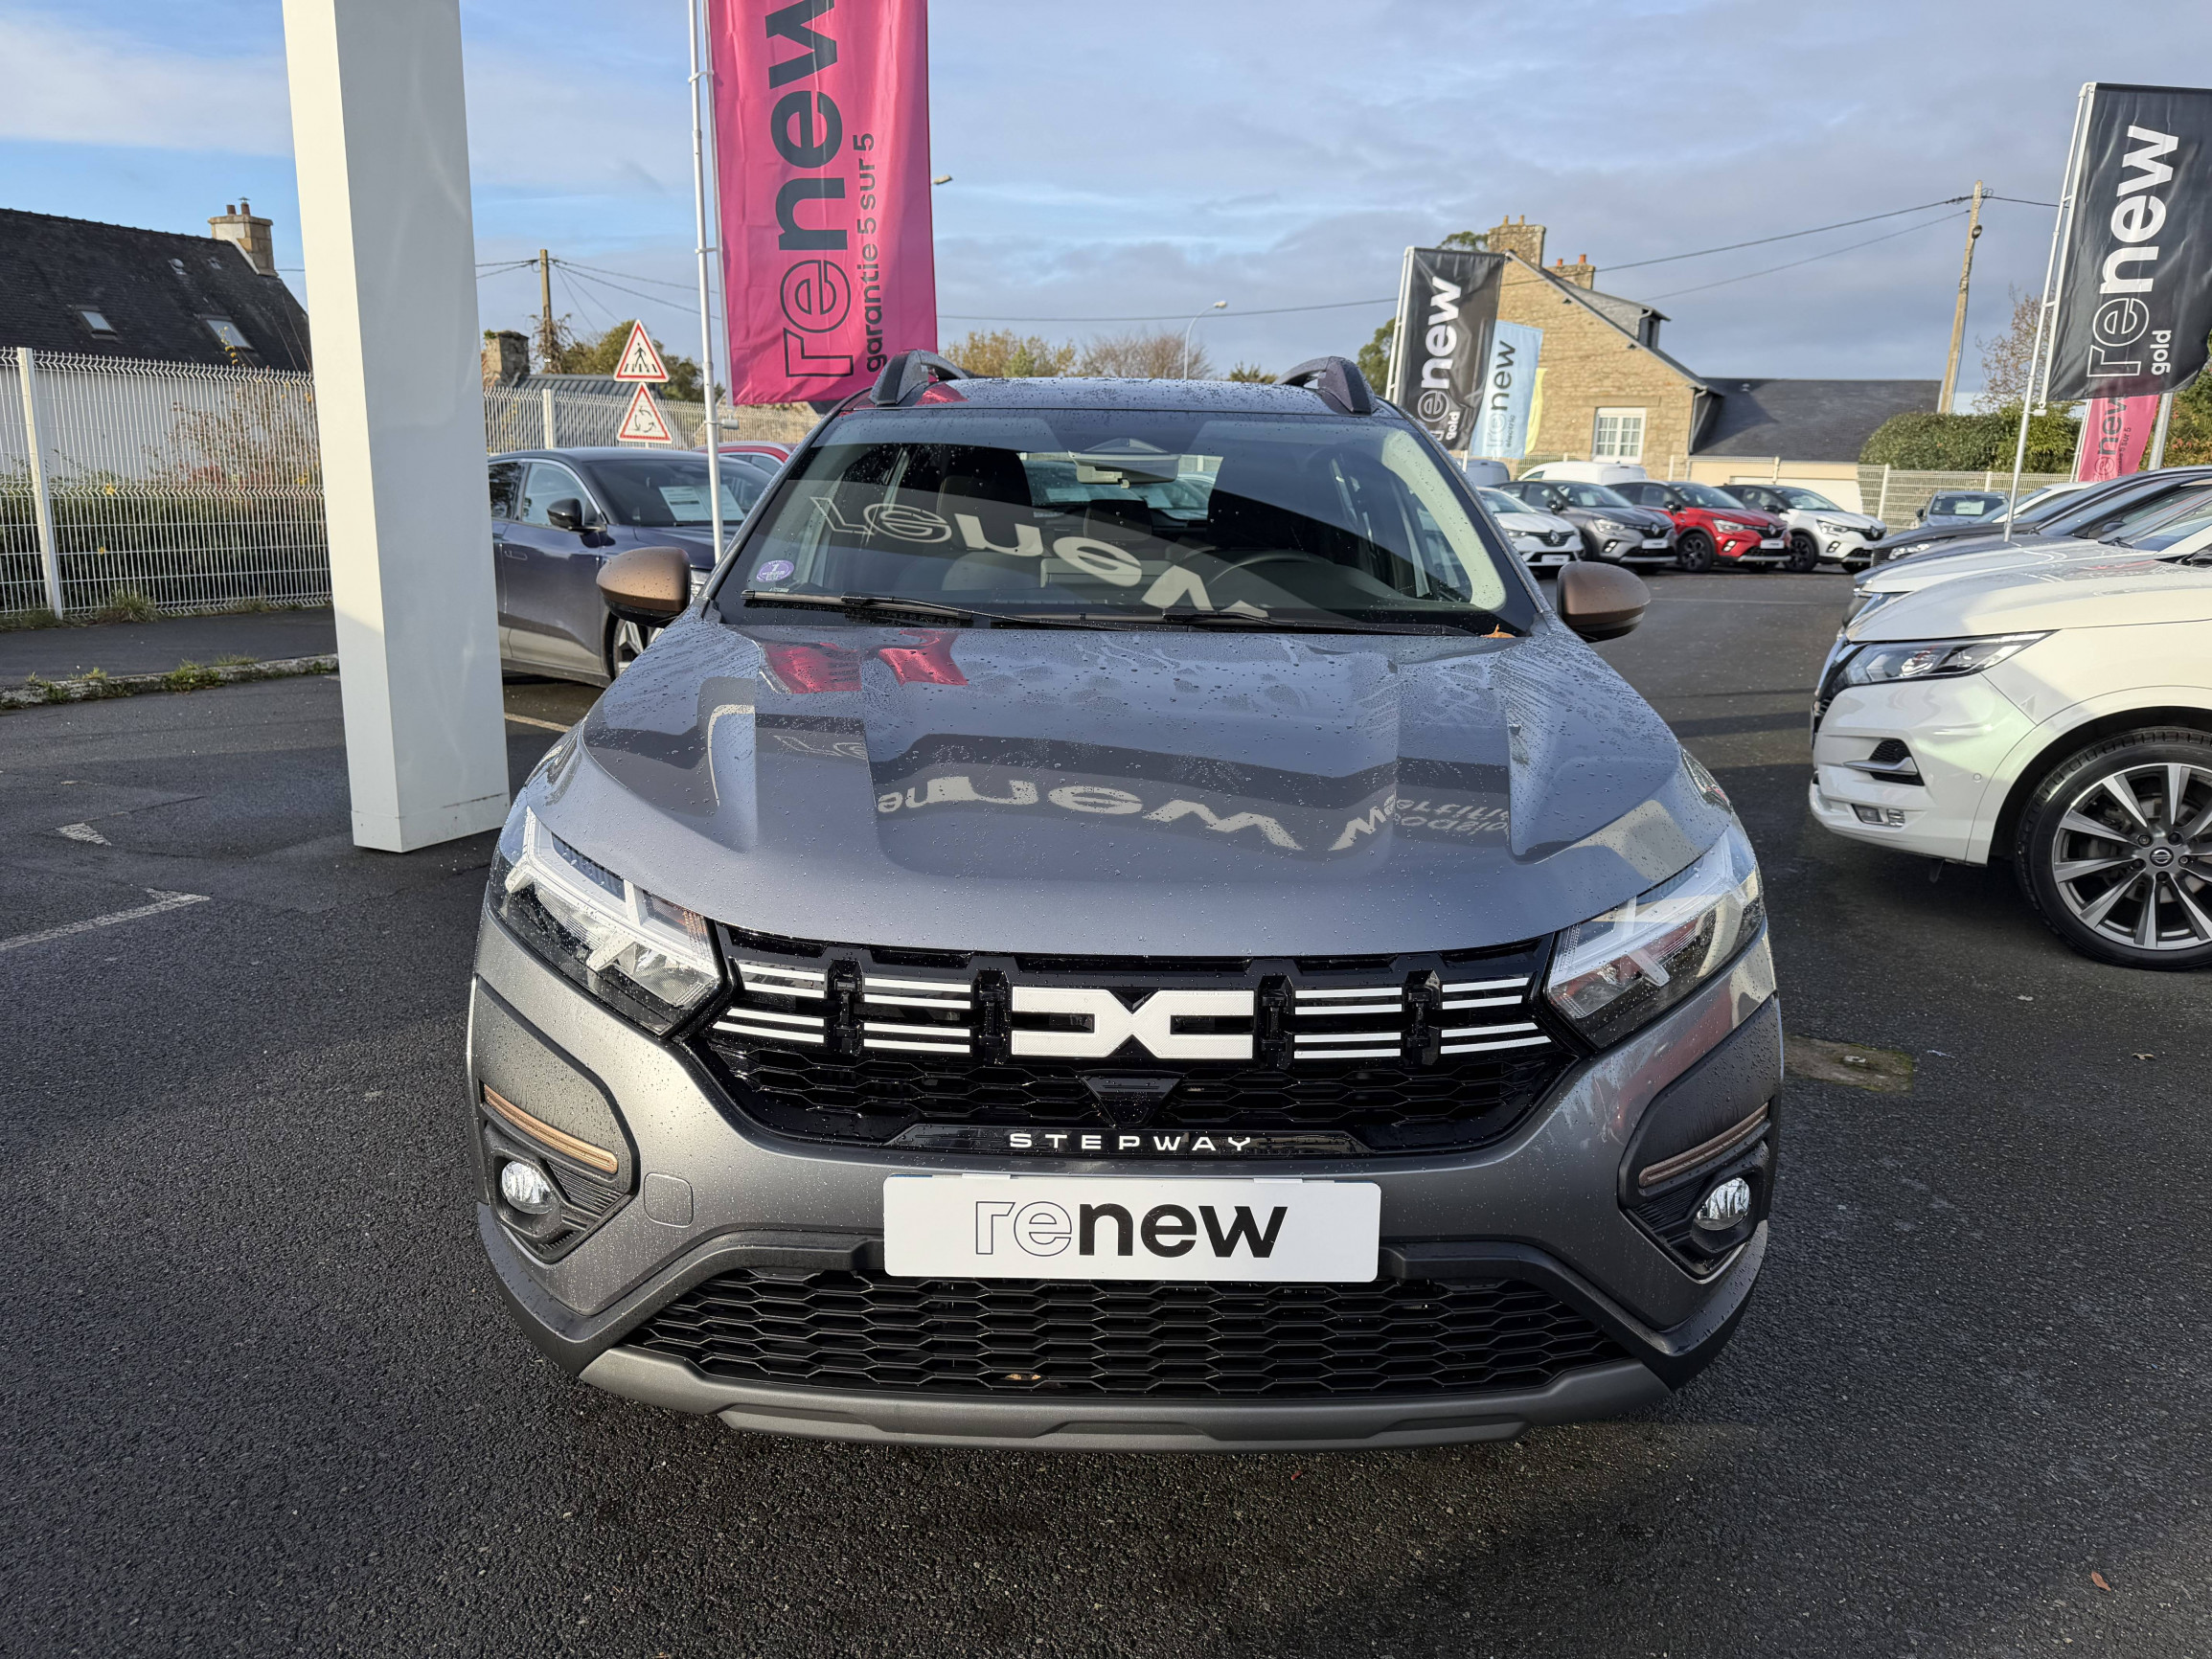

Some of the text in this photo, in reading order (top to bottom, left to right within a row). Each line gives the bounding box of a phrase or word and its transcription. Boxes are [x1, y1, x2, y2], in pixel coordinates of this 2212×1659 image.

[764, 0, 855, 378] renew
[853, 132, 887, 373] garantie 5 sur 5
[2087, 125, 2179, 377] renew
[2150, 330, 2172, 375] gold
[1487, 340, 1516, 447] renew
[1446, 411, 1461, 441] gold
[1506, 415, 1516, 448] electric
[1009, 1132, 1252, 1152] STEPWAY
[975, 1201, 1288, 1259] renew
